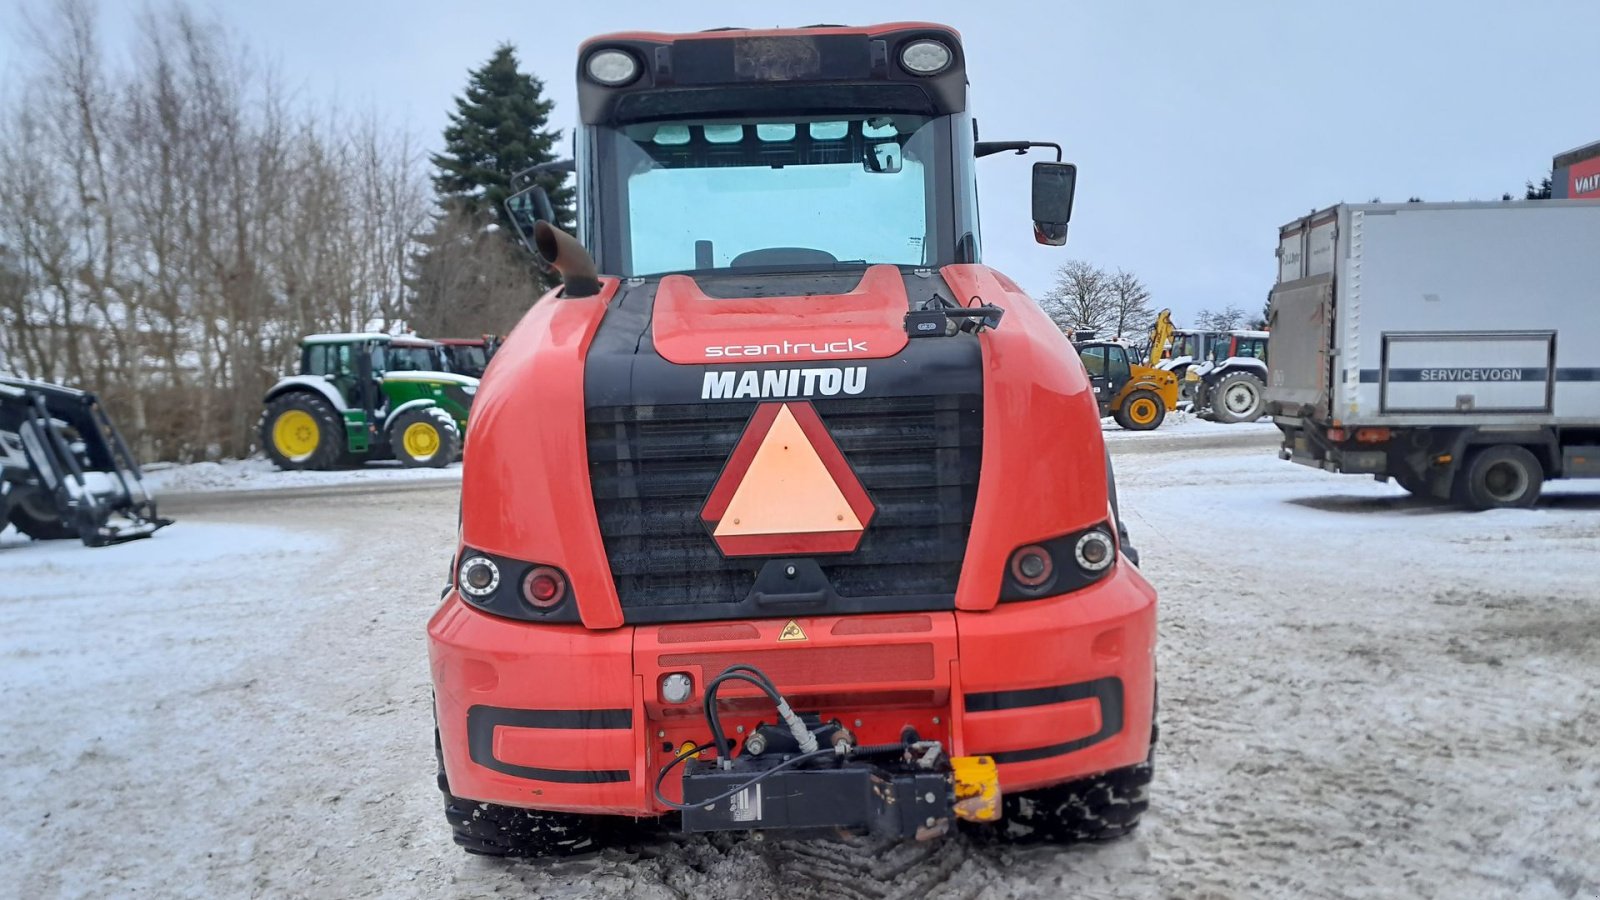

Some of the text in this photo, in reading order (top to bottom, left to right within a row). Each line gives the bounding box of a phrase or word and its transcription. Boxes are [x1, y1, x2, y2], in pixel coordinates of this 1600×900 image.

[704, 338, 868, 357] scantruck
[701, 366, 868, 400] MANITOU
[1420, 369, 1522, 381] SERVICEVOGN
